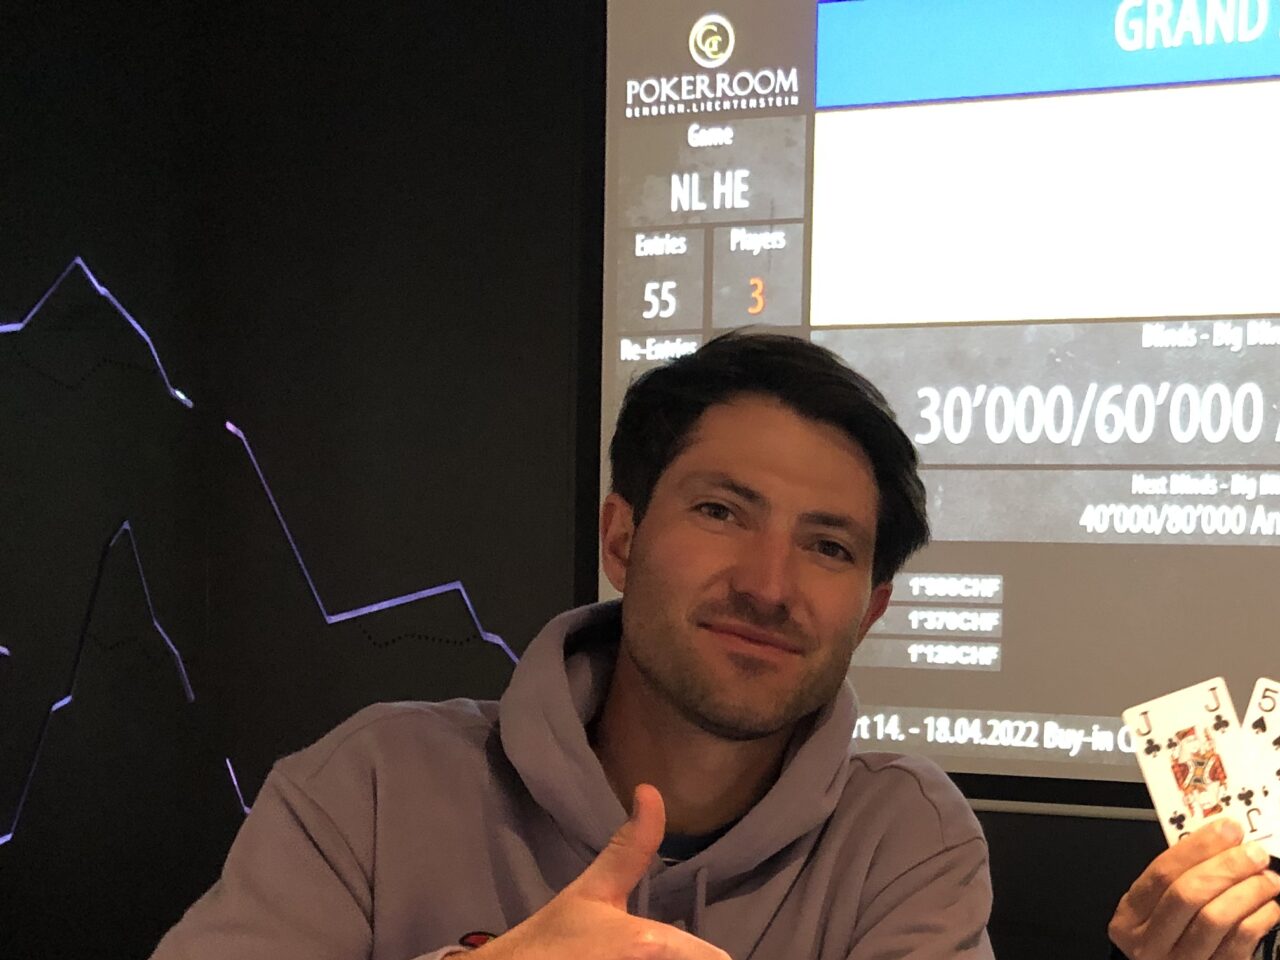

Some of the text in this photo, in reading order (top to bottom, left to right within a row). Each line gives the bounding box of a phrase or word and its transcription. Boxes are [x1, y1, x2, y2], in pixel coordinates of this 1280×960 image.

[1114, 0, 1270, 51] GRAND
[687, 122, 733, 148] Game
[670, 170, 750, 213] NL HE
[635, 232, 687, 257] Entries
[730, 227, 786, 255] Players
[642, 281, 677, 319] 55
[747, 277, 765, 315] 3
[1204, 687, 1221, 713] J
[1257, 688, 1279, 713] 5
[874, 714, 905, 741] 14.
[924, 716, 1039, 748] 18.04.2022
[1044, 722, 1113, 756] Buy-in
[1136, 711, 1151, 737] J
